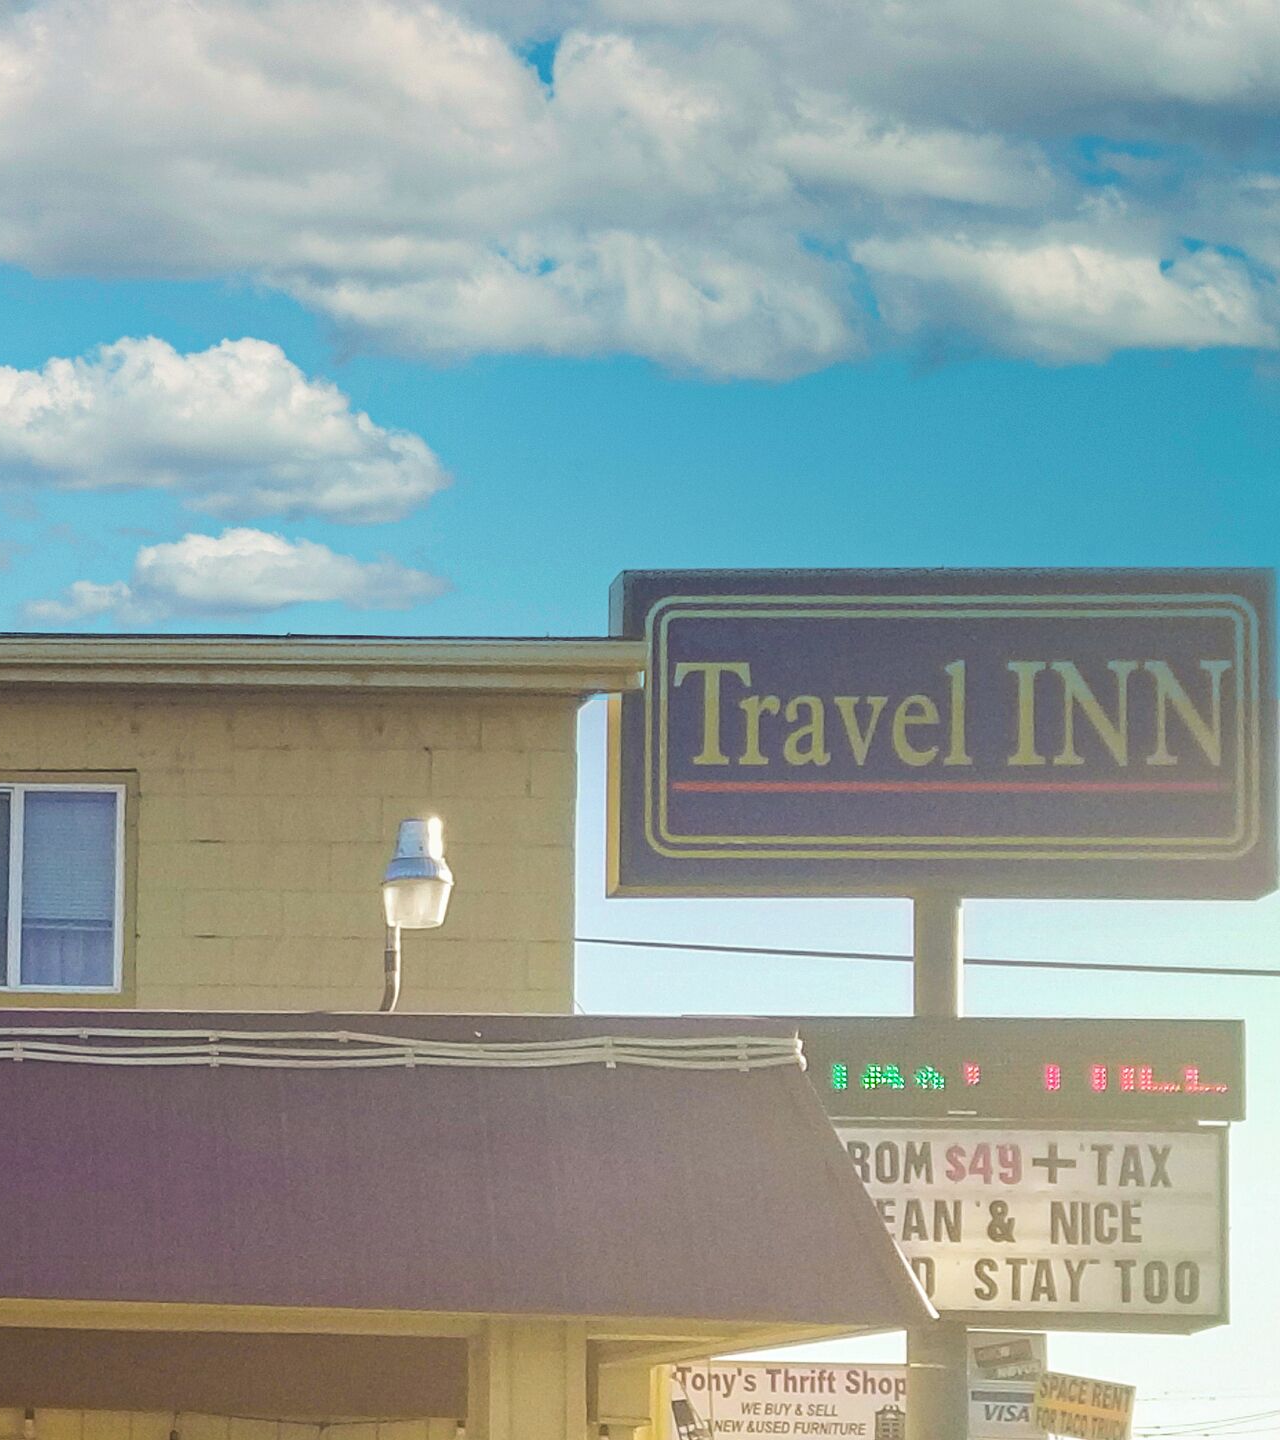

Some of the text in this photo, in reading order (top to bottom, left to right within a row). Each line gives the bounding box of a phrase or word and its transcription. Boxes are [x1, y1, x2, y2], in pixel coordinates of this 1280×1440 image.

[673, 658, 1232, 767] Travel INN
[945, 1141, 1023, 1186] $49
[1090, 1143, 1174, 1188] TAX
[987, 1199, 1017, 1243] &
[1050, 1200, 1143, 1245] NICE
[974, 1257, 1090, 1302] STAY
[1115, 1259, 1201, 1305] TOO
[676, 1366, 907, 1401] Tony's Thrift Shop
[1040, 1374, 1133, 1412] SPACE RENT
[713, 1420, 744, 1433] NEW
[793, 1421, 867, 1436] FURNITURE
[741, 1402, 839, 1418] WE BUY & SELL
[984, 1404, 1030, 1423] VISA
